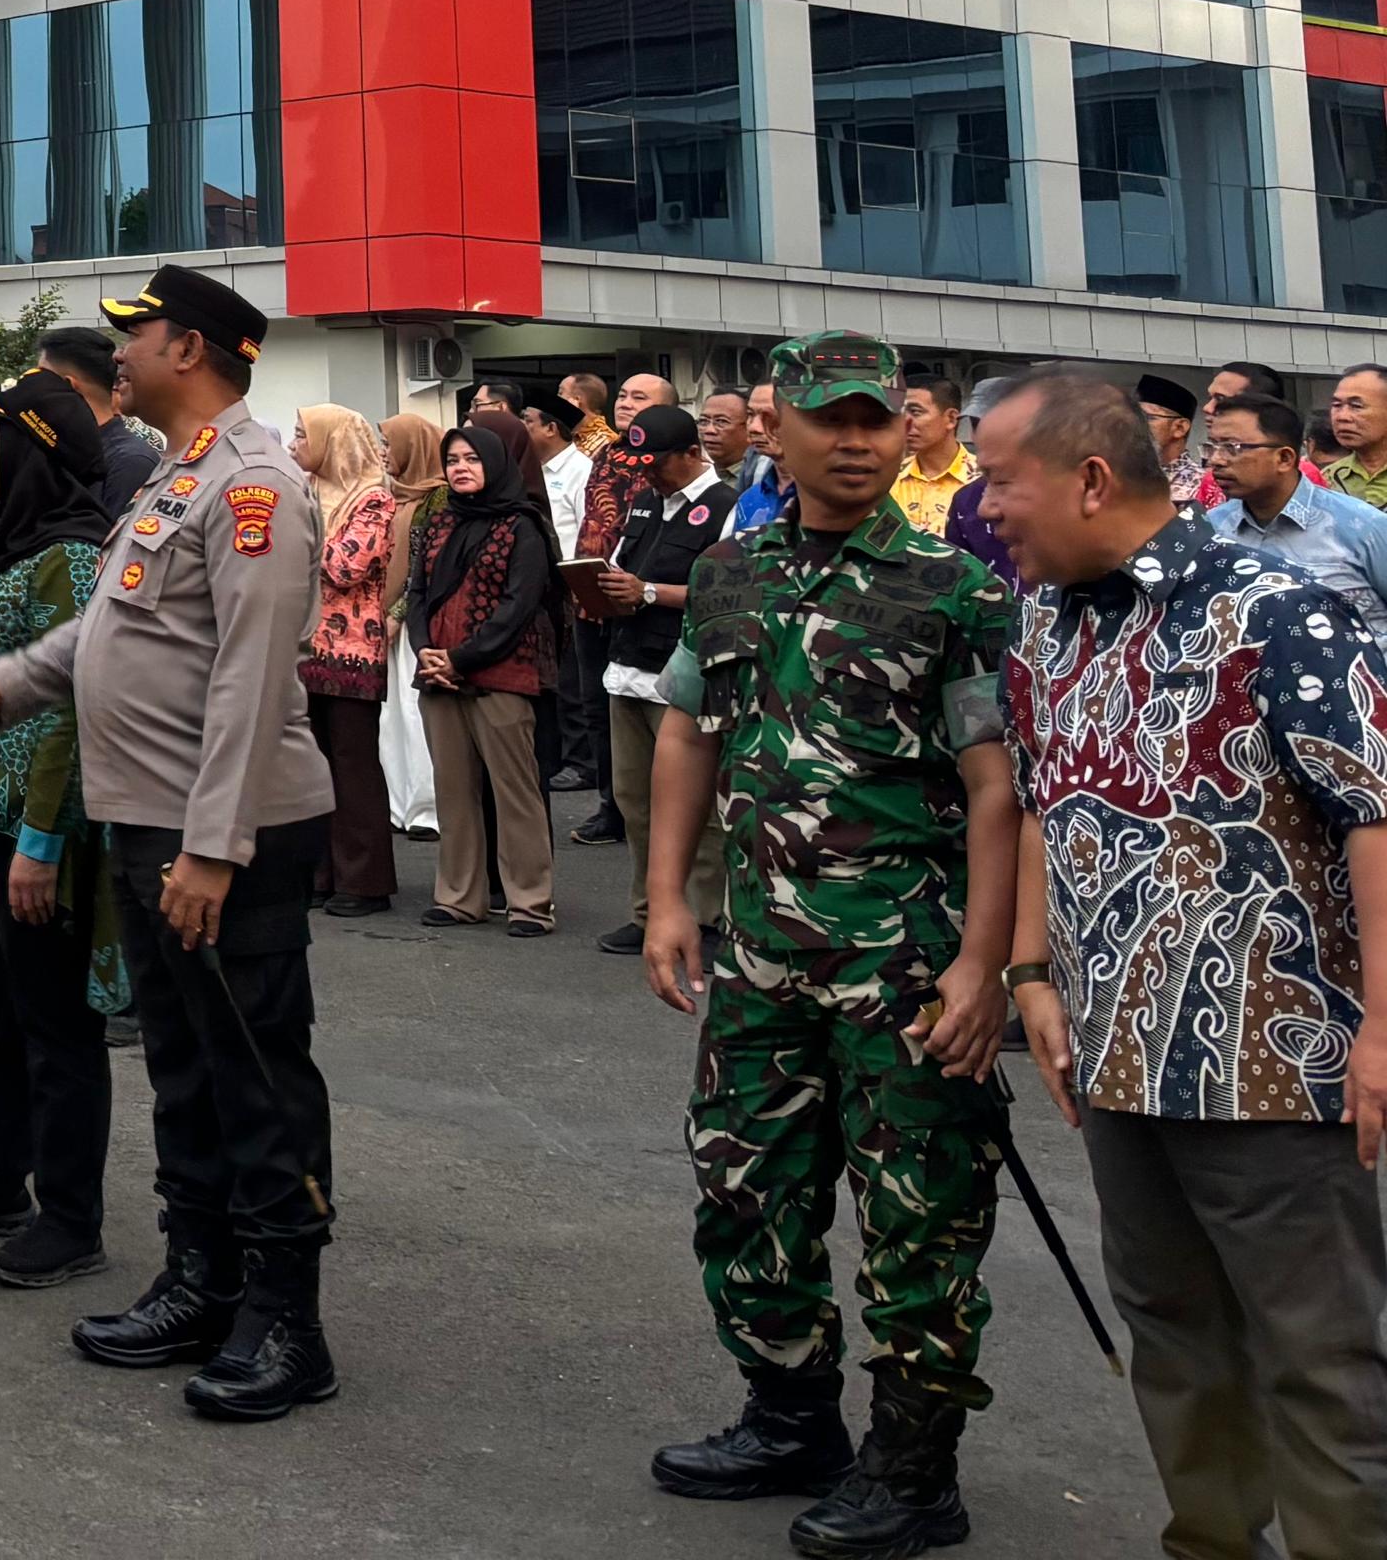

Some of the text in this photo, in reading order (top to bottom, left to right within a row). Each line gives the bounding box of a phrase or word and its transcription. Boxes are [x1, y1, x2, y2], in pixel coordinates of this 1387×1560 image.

[151, 498, 187, 519] POLRI
[841, 601, 938, 639] TNI AD
